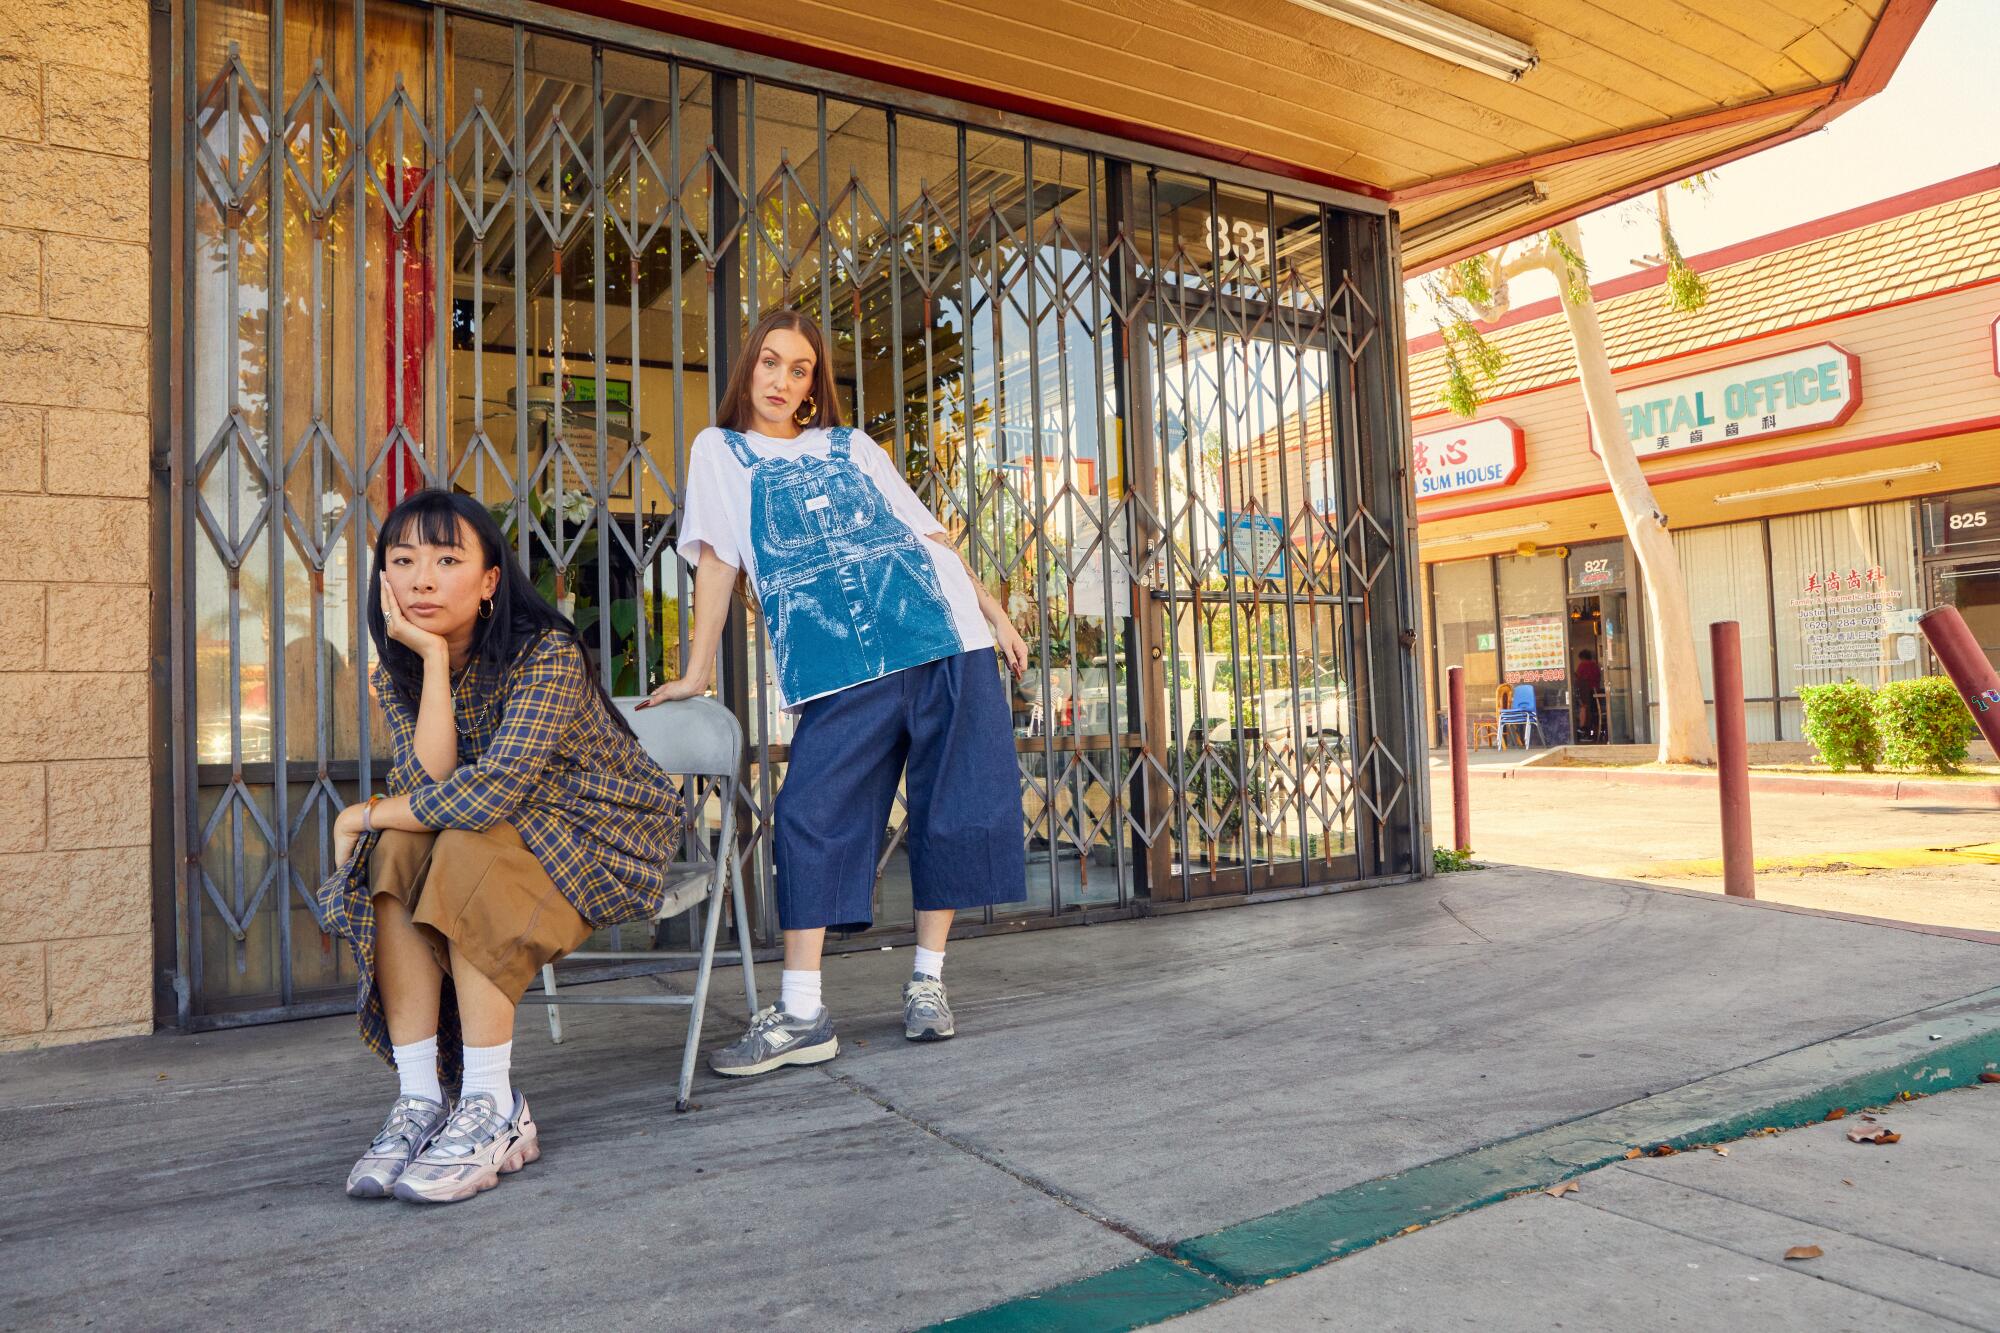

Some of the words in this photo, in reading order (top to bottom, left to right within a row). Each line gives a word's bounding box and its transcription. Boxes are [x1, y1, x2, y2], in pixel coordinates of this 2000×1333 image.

[1206, 216, 1270, 265] 831
[1619, 391, 1715, 441] ENTAL
[1724, 360, 1841, 420] OFFICE
[1423, 472, 1451, 492] SUM
[1456, 463, 1503, 486] HOUSE
[1949, 511, 1987, 530] 825
[1584, 558, 1609, 573] 827
[1790, 599, 1814, 607] Family
[1865, 590, 1903, 600] Dentistry
[1798, 608, 1826, 618] Justin
[1842, 605, 1862, 614] Liao
[1837, 618, 1856, 627] 284
